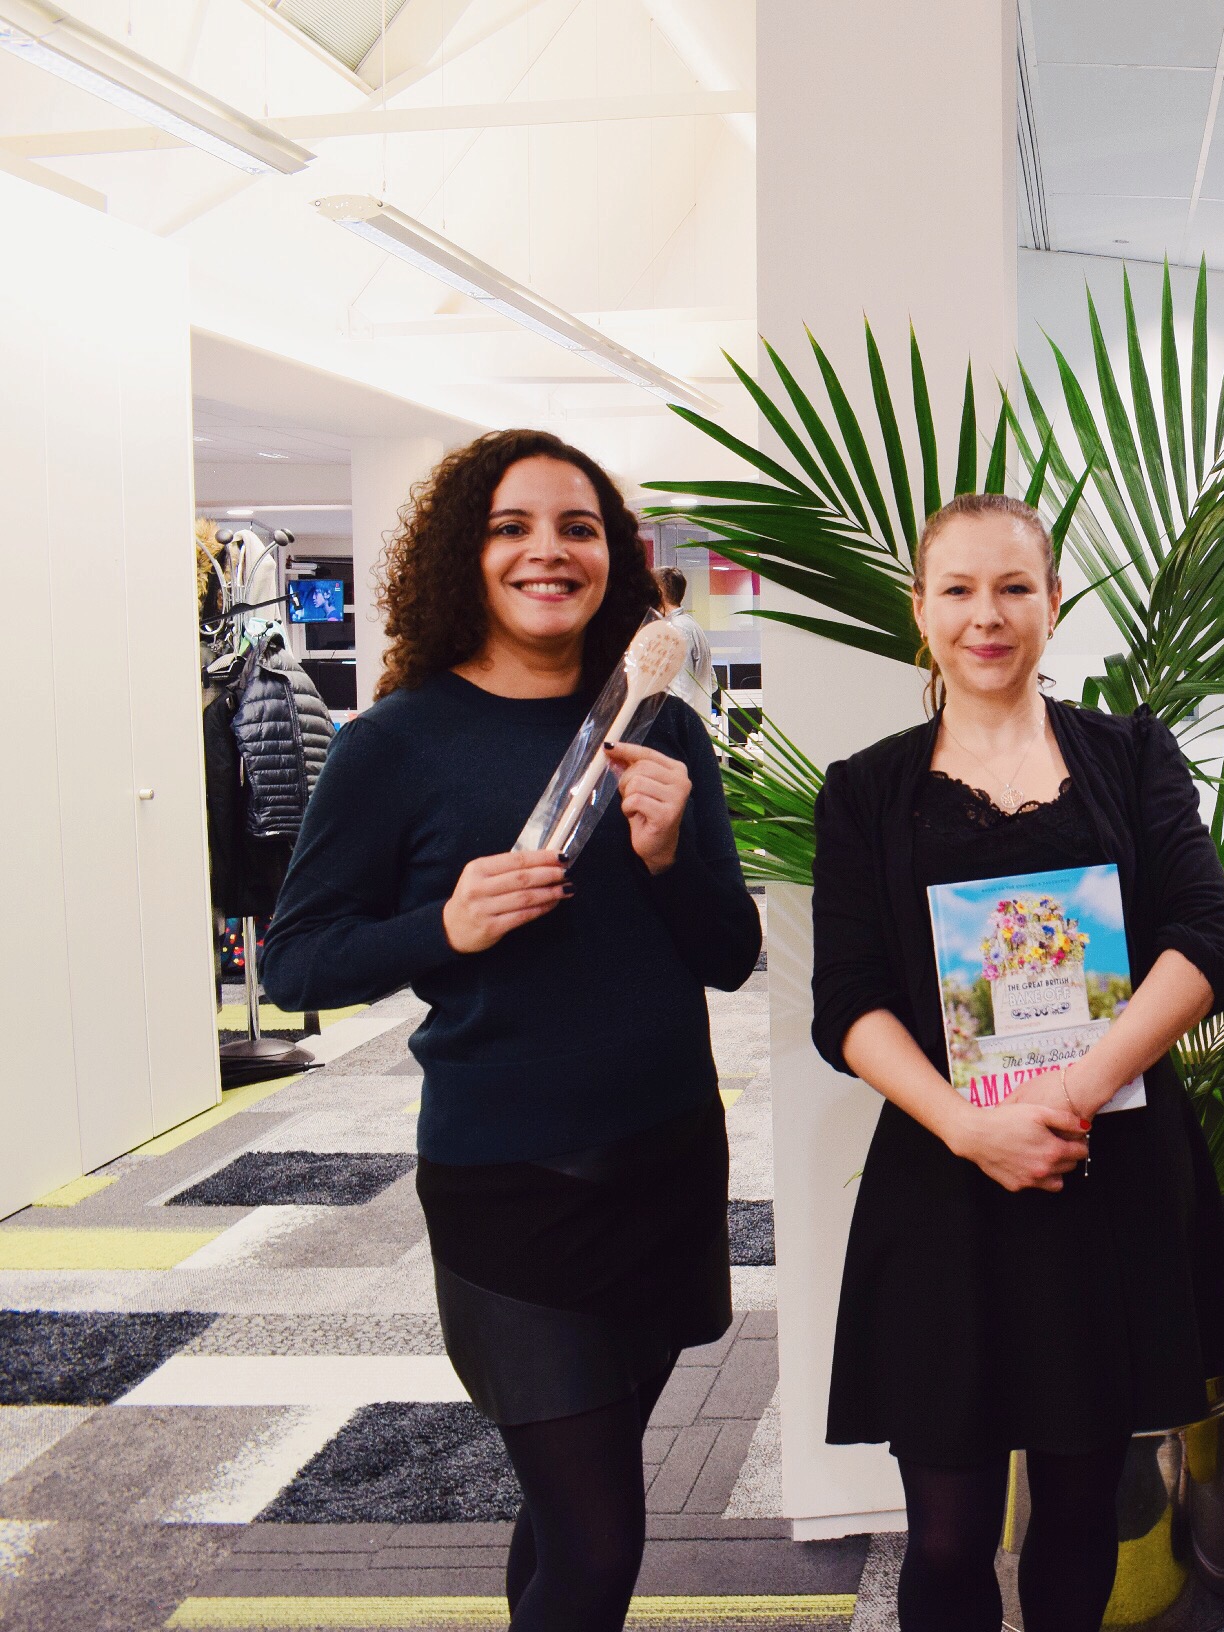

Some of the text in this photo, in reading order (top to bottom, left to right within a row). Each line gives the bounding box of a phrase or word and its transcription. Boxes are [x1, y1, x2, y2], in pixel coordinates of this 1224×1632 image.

[1008, 977, 1069, 991] THE GREAT BRITISH
[1008, 985, 1070, 1006] BAKE OFF
[1002, 1055, 1023, 1069] The
[1025, 1051, 1045, 1067] Big
[1047, 1048, 1077, 1062] Book
[970, 1065, 1060, 1107] AMAZ
